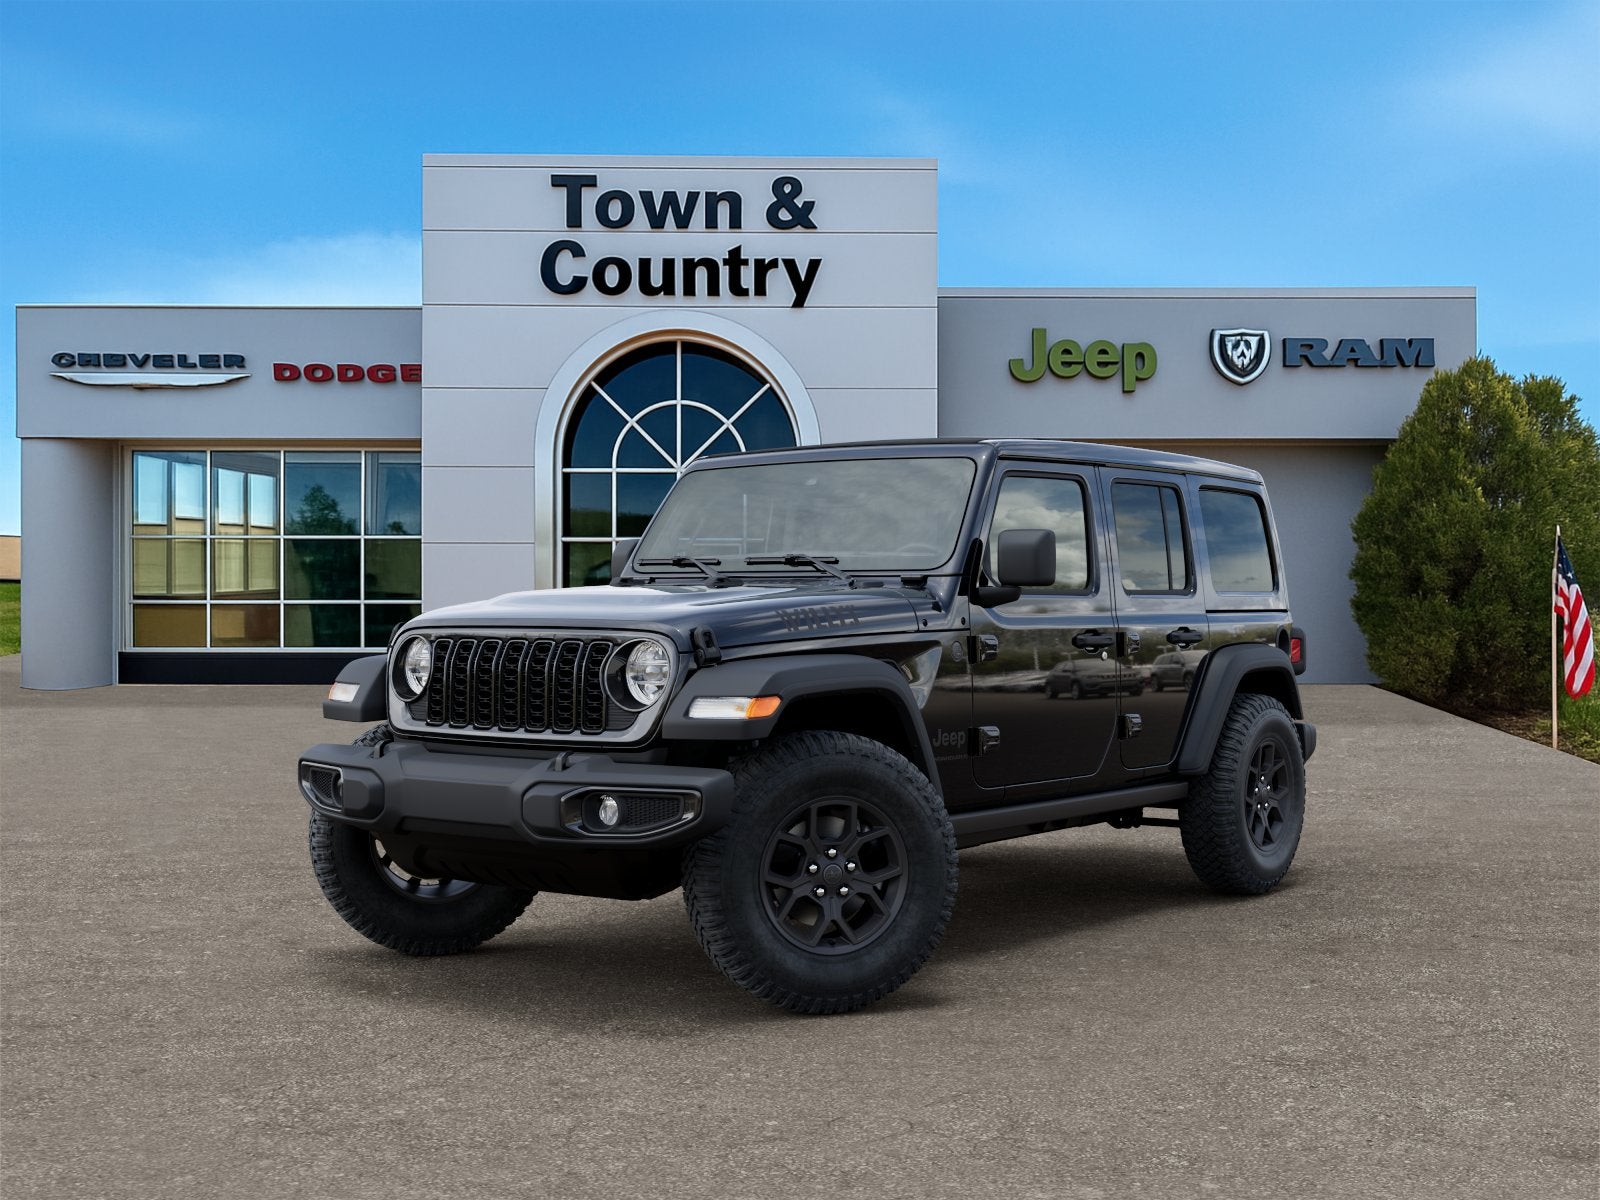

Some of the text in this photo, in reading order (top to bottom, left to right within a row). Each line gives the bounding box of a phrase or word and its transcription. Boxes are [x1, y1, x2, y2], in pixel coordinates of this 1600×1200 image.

[551, 174, 818, 229] Town &
[540, 239, 822, 308] Country
[273, 363, 422, 383] DODGE
[1009, 327, 1158, 393] Jeep
[1283, 337, 1435, 368] RAM
[932, 728, 966, 748] Jeep
